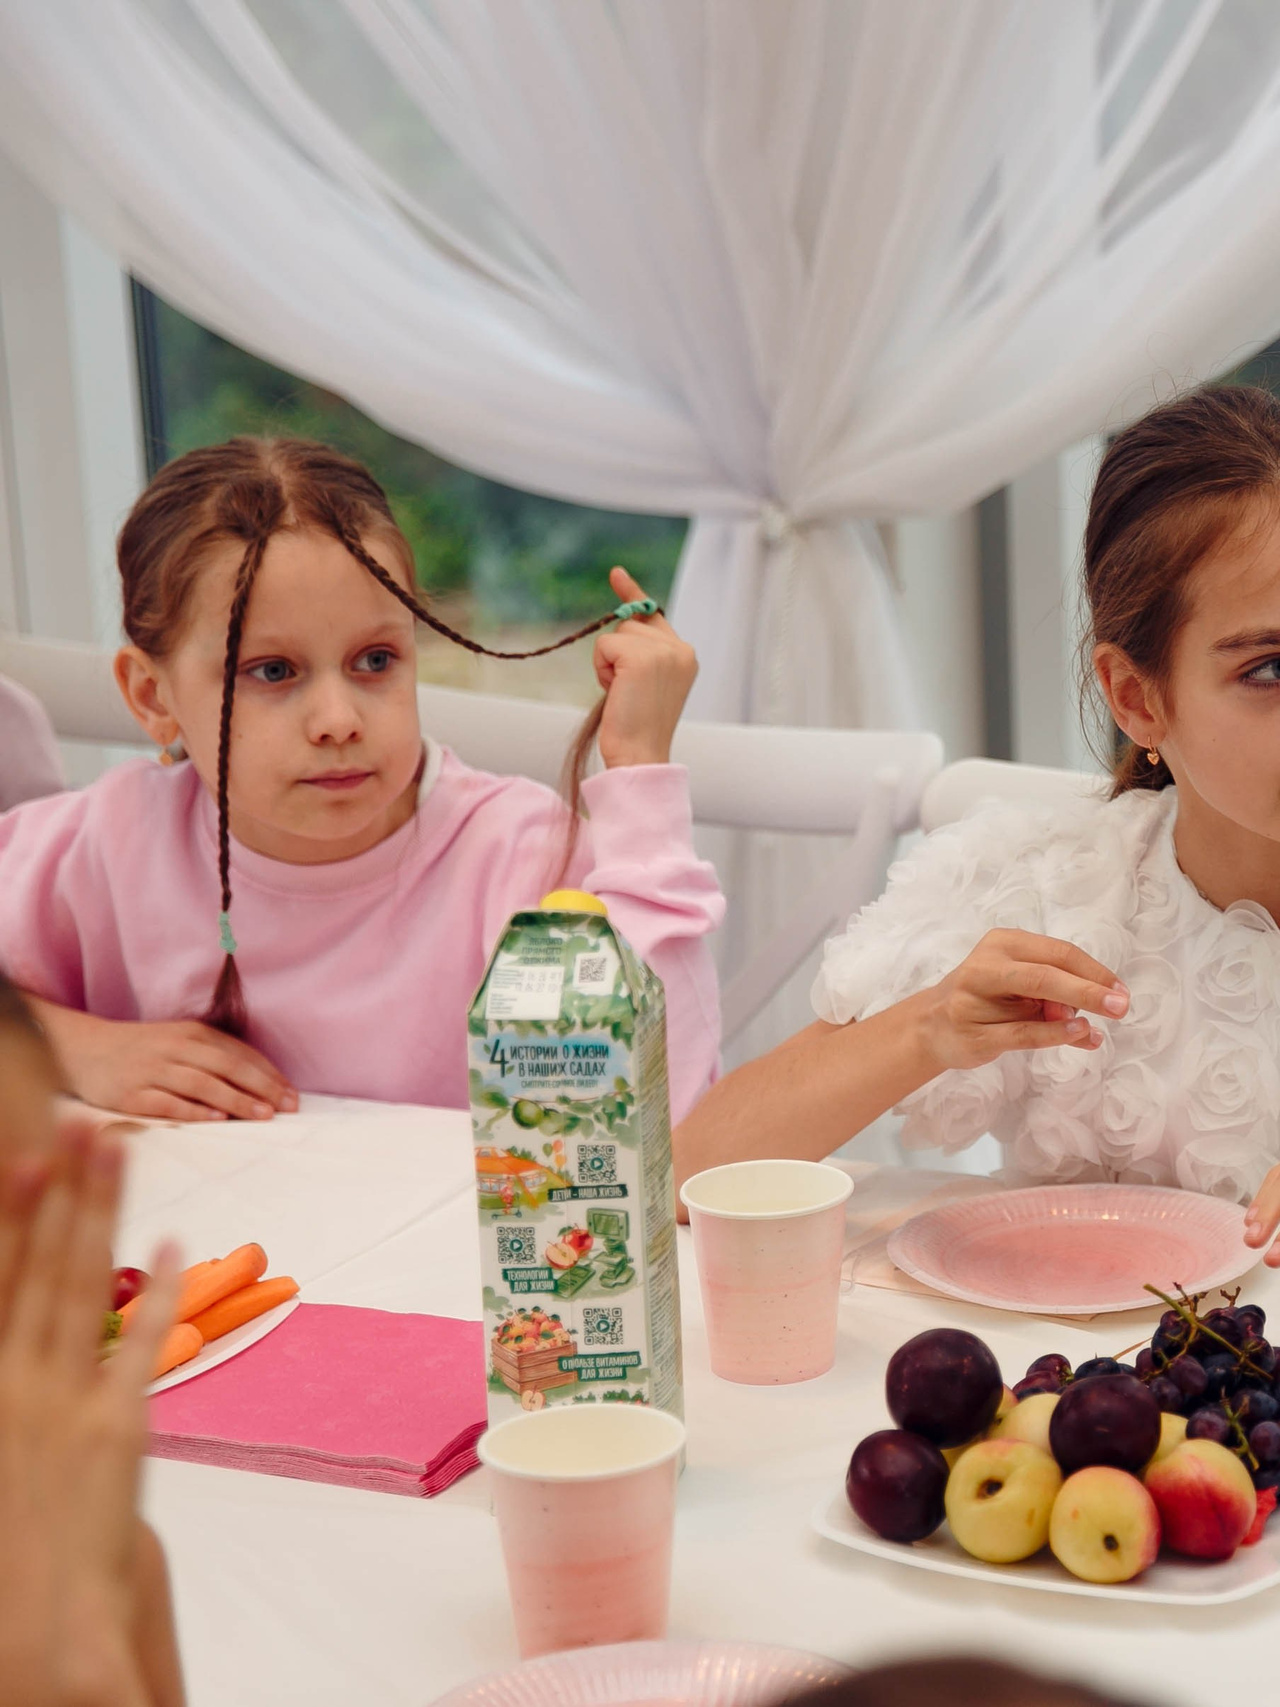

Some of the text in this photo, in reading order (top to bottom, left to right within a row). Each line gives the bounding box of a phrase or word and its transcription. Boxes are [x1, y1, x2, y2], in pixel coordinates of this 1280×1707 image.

[489, 1039, 610, 1078] 4 ИСТОРИИ О ЖИЗНИ
[518, 1062, 607, 1077] В НАШИХ САДАХ
[552, 1188, 571, 1201] ДЕТИ
[579, 1187, 598, 1199] НАША
[599, 1185, 622, 1198] ЖИЗНЬ
[507, 1270, 549, 1281] ТЕХНОЛОГИИ
[514, 1280, 555, 1292] ДЛЯ ЖИЗНИ
[562, 1355, 638, 1369] О ПОЛЬЗЕ ВИТАМИНОВ
[581, 1367, 623, 1379] ДЛЯ ЖИЗНИ
